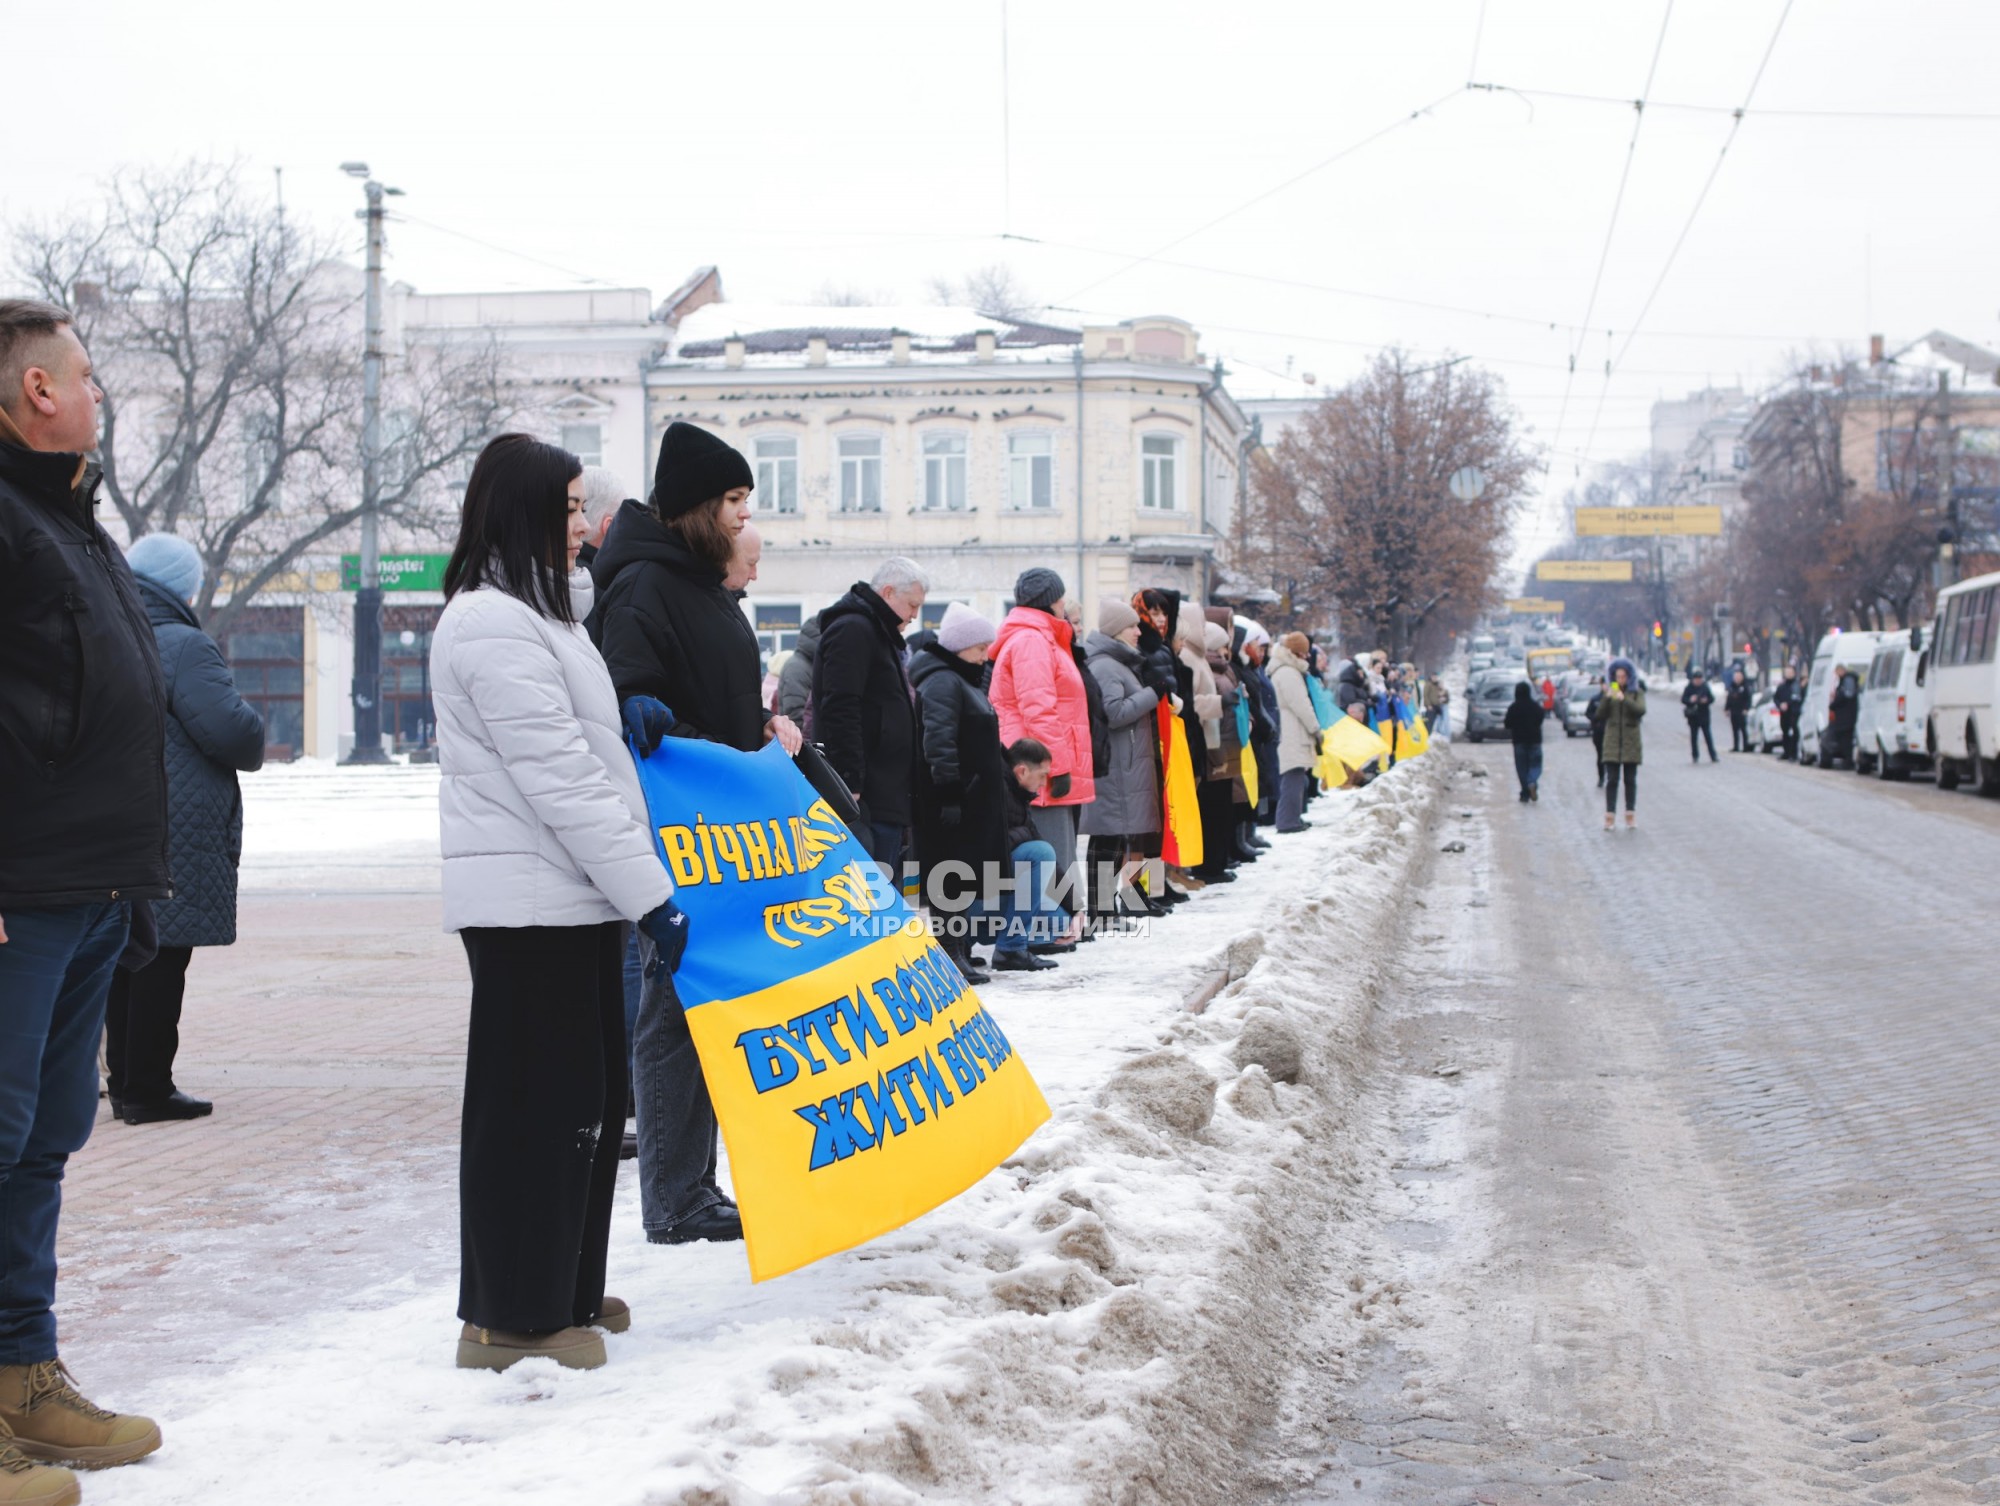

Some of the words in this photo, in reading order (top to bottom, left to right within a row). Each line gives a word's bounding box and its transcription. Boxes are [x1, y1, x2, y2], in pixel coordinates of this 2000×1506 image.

[659, 811, 796, 888] ВІЧНА
[734, 983, 889, 1095] БУТИ
[792, 1045, 955, 1173] ЖИТИ
